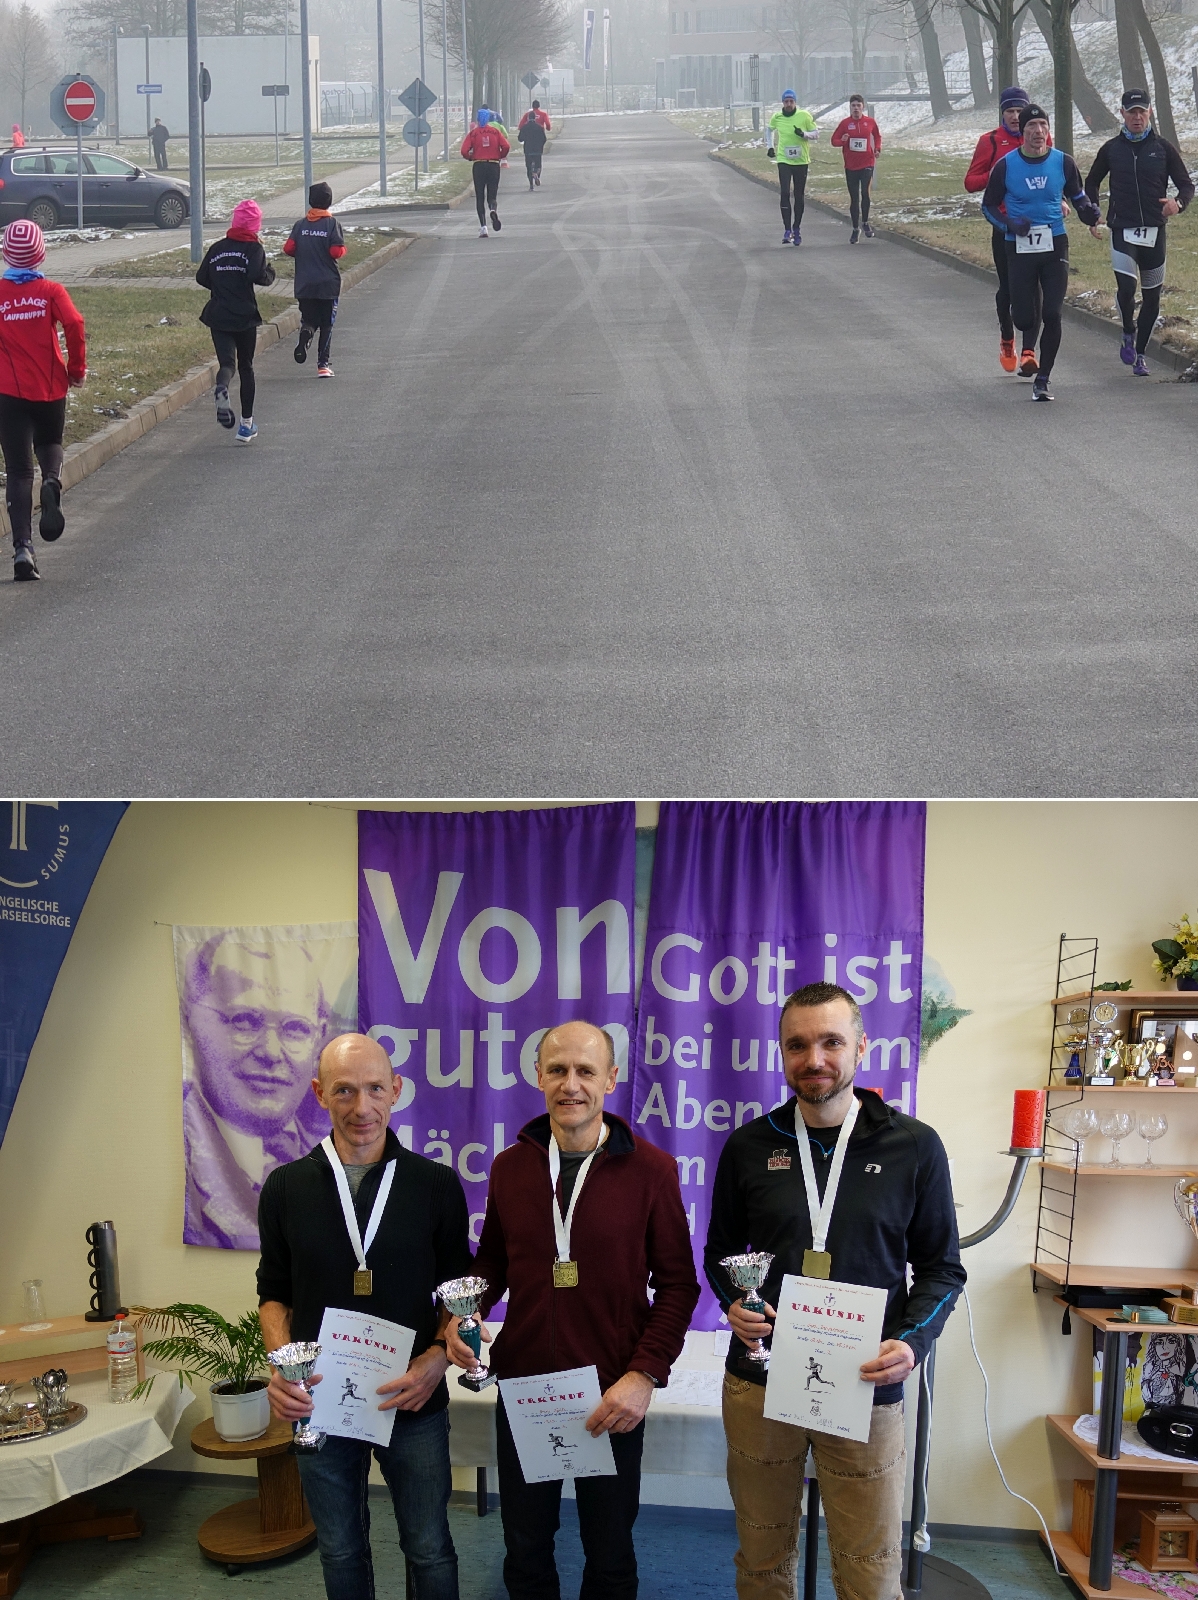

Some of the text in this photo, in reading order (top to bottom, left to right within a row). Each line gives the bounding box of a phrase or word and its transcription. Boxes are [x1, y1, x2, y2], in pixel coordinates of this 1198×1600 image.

[310, 229, 328, 238] LAAGE
[1027, 233, 1042, 246] 17
[1133, 227, 1148, 239] 41
[0, 297, 48, 313] SC LAAGE
[4, 310, 47, 321] LAUFGRUPPE
[41, 824, 70, 880] SUMUS
[0, 909, 71, 928] RSEELSORGE
[363, 868, 630, 1004] Von
[651, 933, 914, 1008] Gott ist
[644, 1016, 714, 1071] bei
[636, 1079, 789, 1132] Abend
[791, 1302, 866, 1323] URKUNDE
[331, 1332, 398, 1355] URKUNDE
[516, 1391, 585, 1405] URKUNDE
